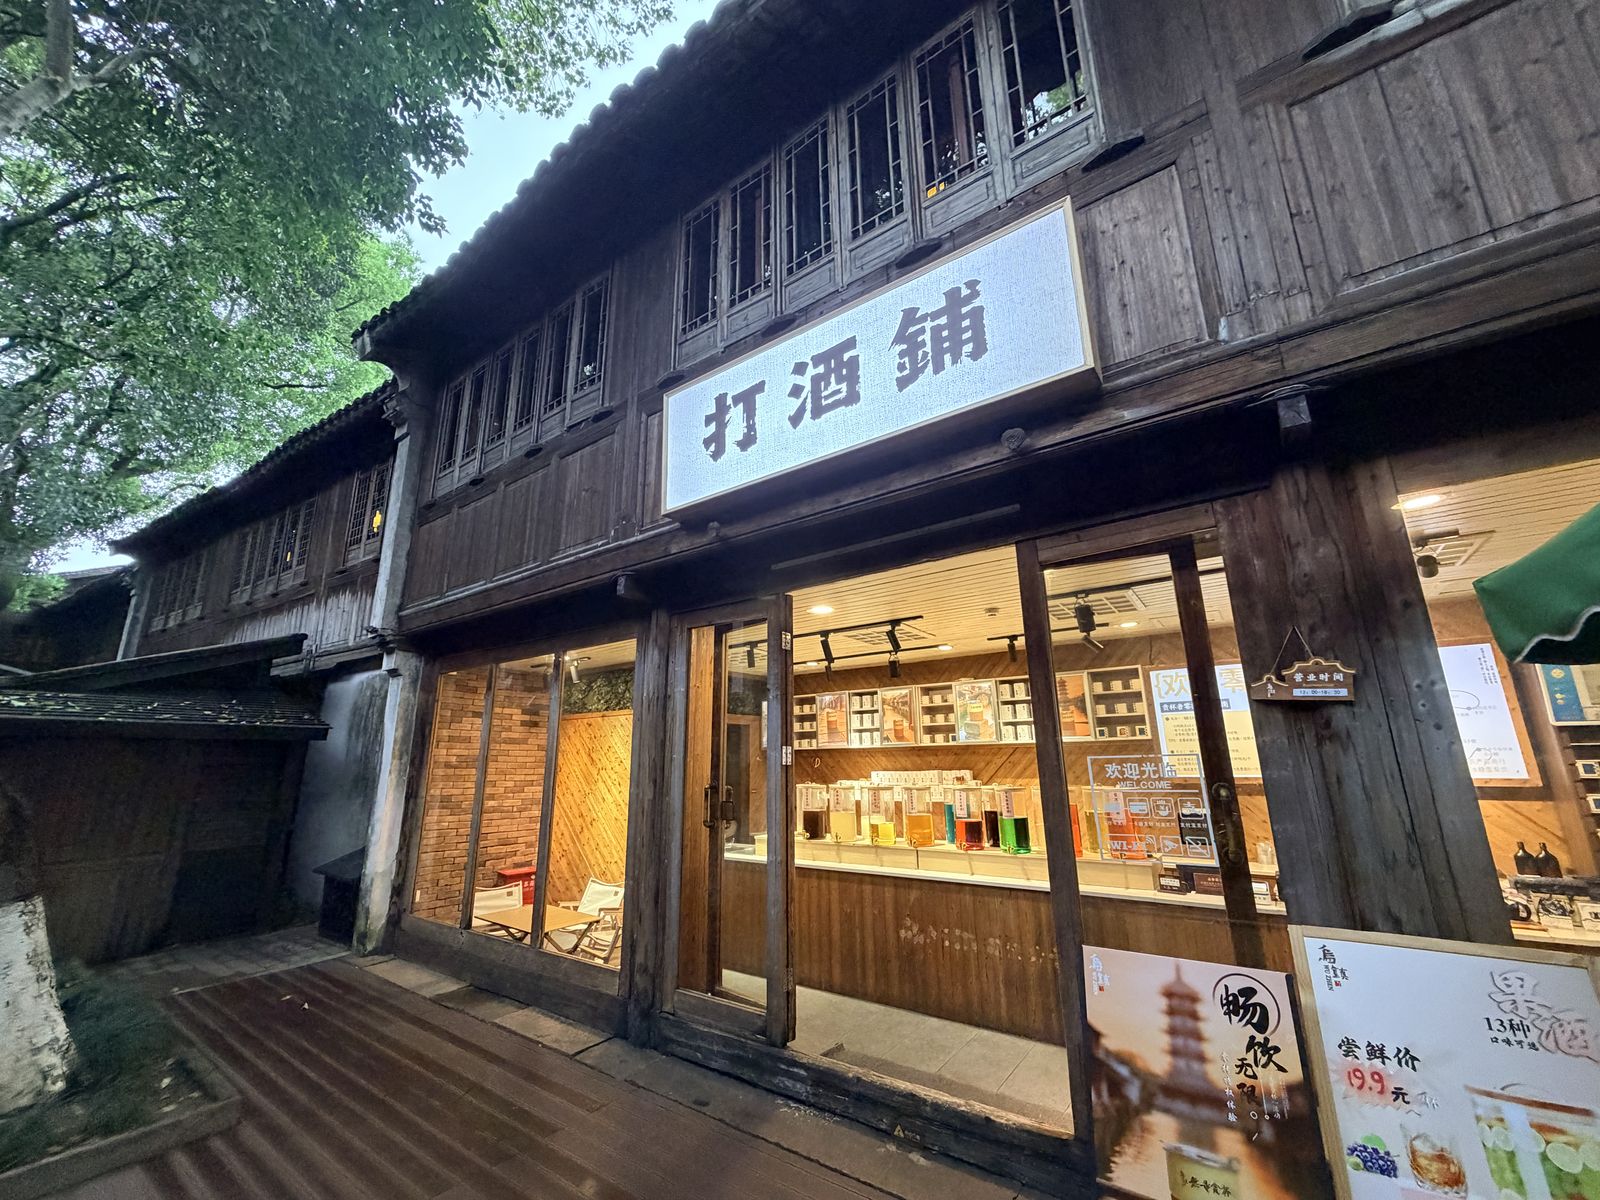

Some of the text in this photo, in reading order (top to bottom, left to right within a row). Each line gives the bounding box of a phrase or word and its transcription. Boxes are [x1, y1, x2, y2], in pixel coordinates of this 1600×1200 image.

[1293, 672, 1344, 683] 营业时间
[1104, 762, 1177, 779] 欢迎光临
[1117, 781, 1172, 789] WELCOME
[1484, 1017, 1531, 1039] 13种
[1490, 1036, 1540, 1052] 口味可选
[1337, 1036, 1422, 1073] 尝鲜价
